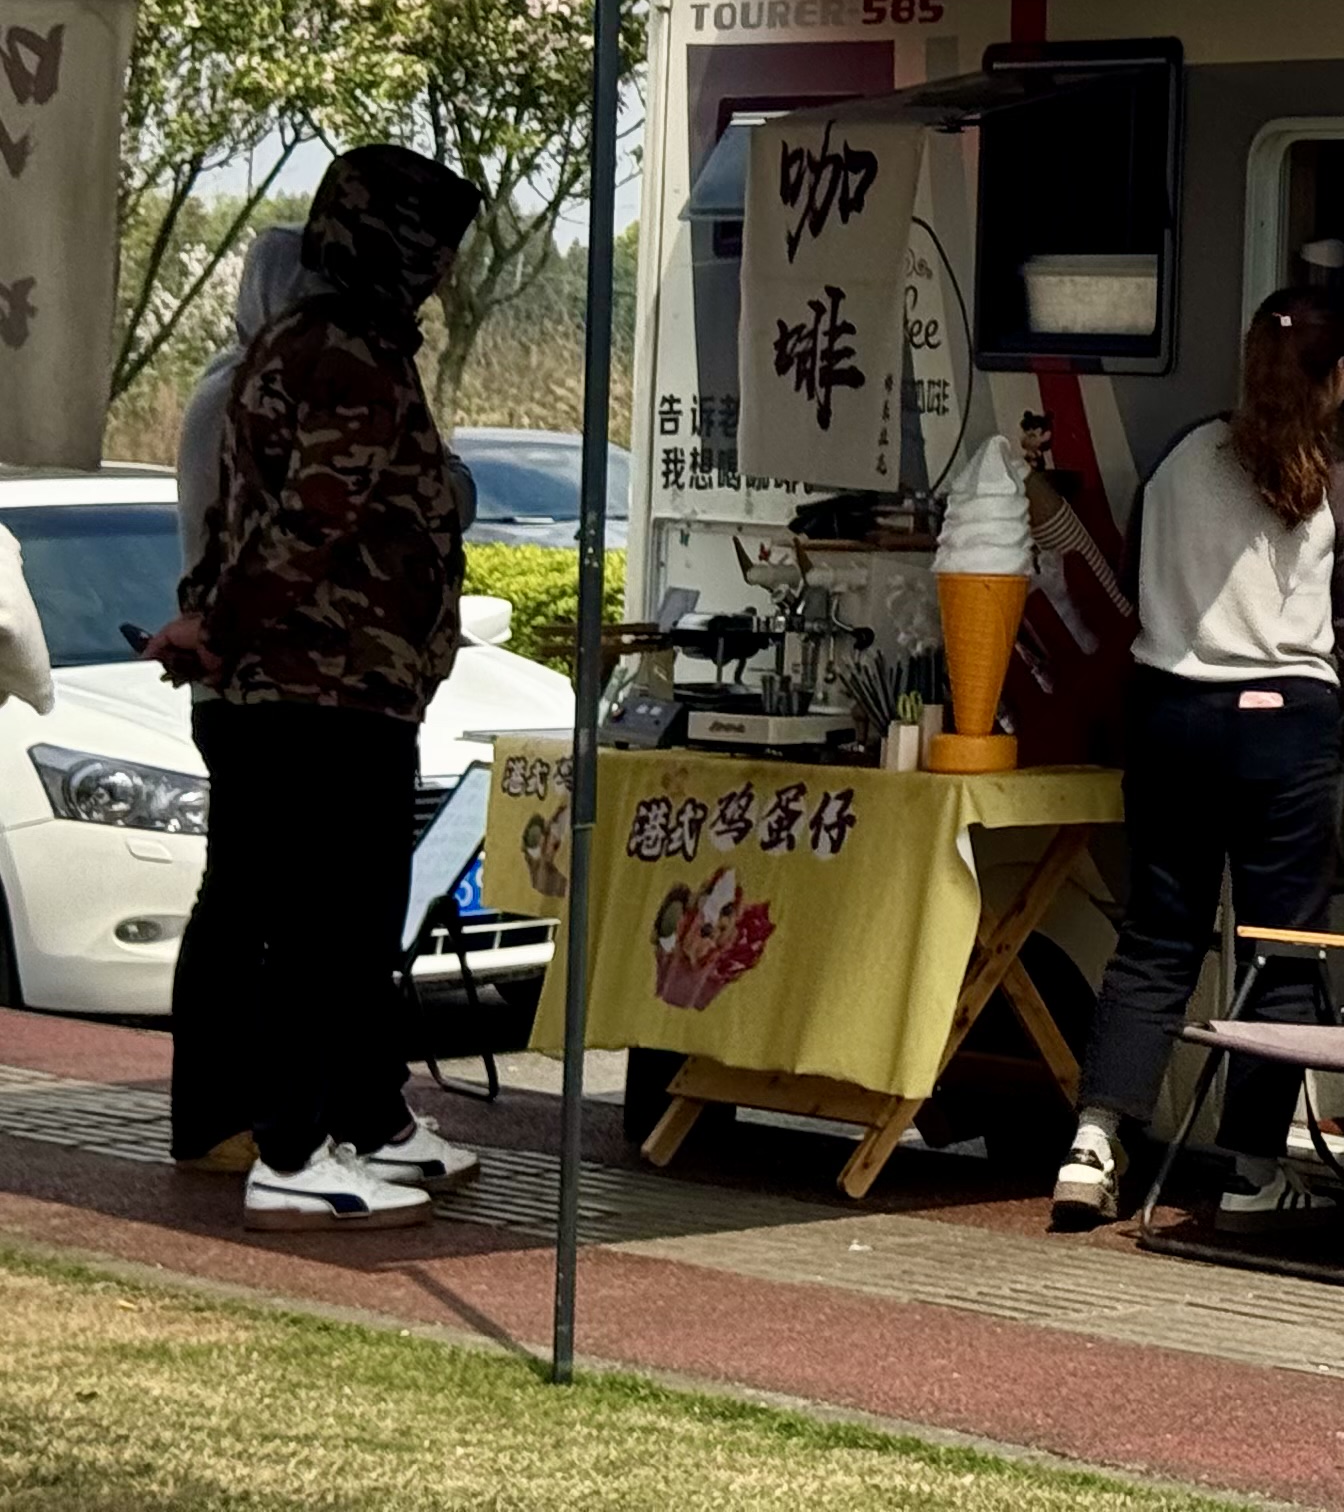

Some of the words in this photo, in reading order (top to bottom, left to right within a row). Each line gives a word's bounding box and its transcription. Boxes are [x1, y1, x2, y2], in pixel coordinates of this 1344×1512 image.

[774, 118, 879, 432] 咖啡
[627, 780, 858, 862] 港式鸡蛋仔
